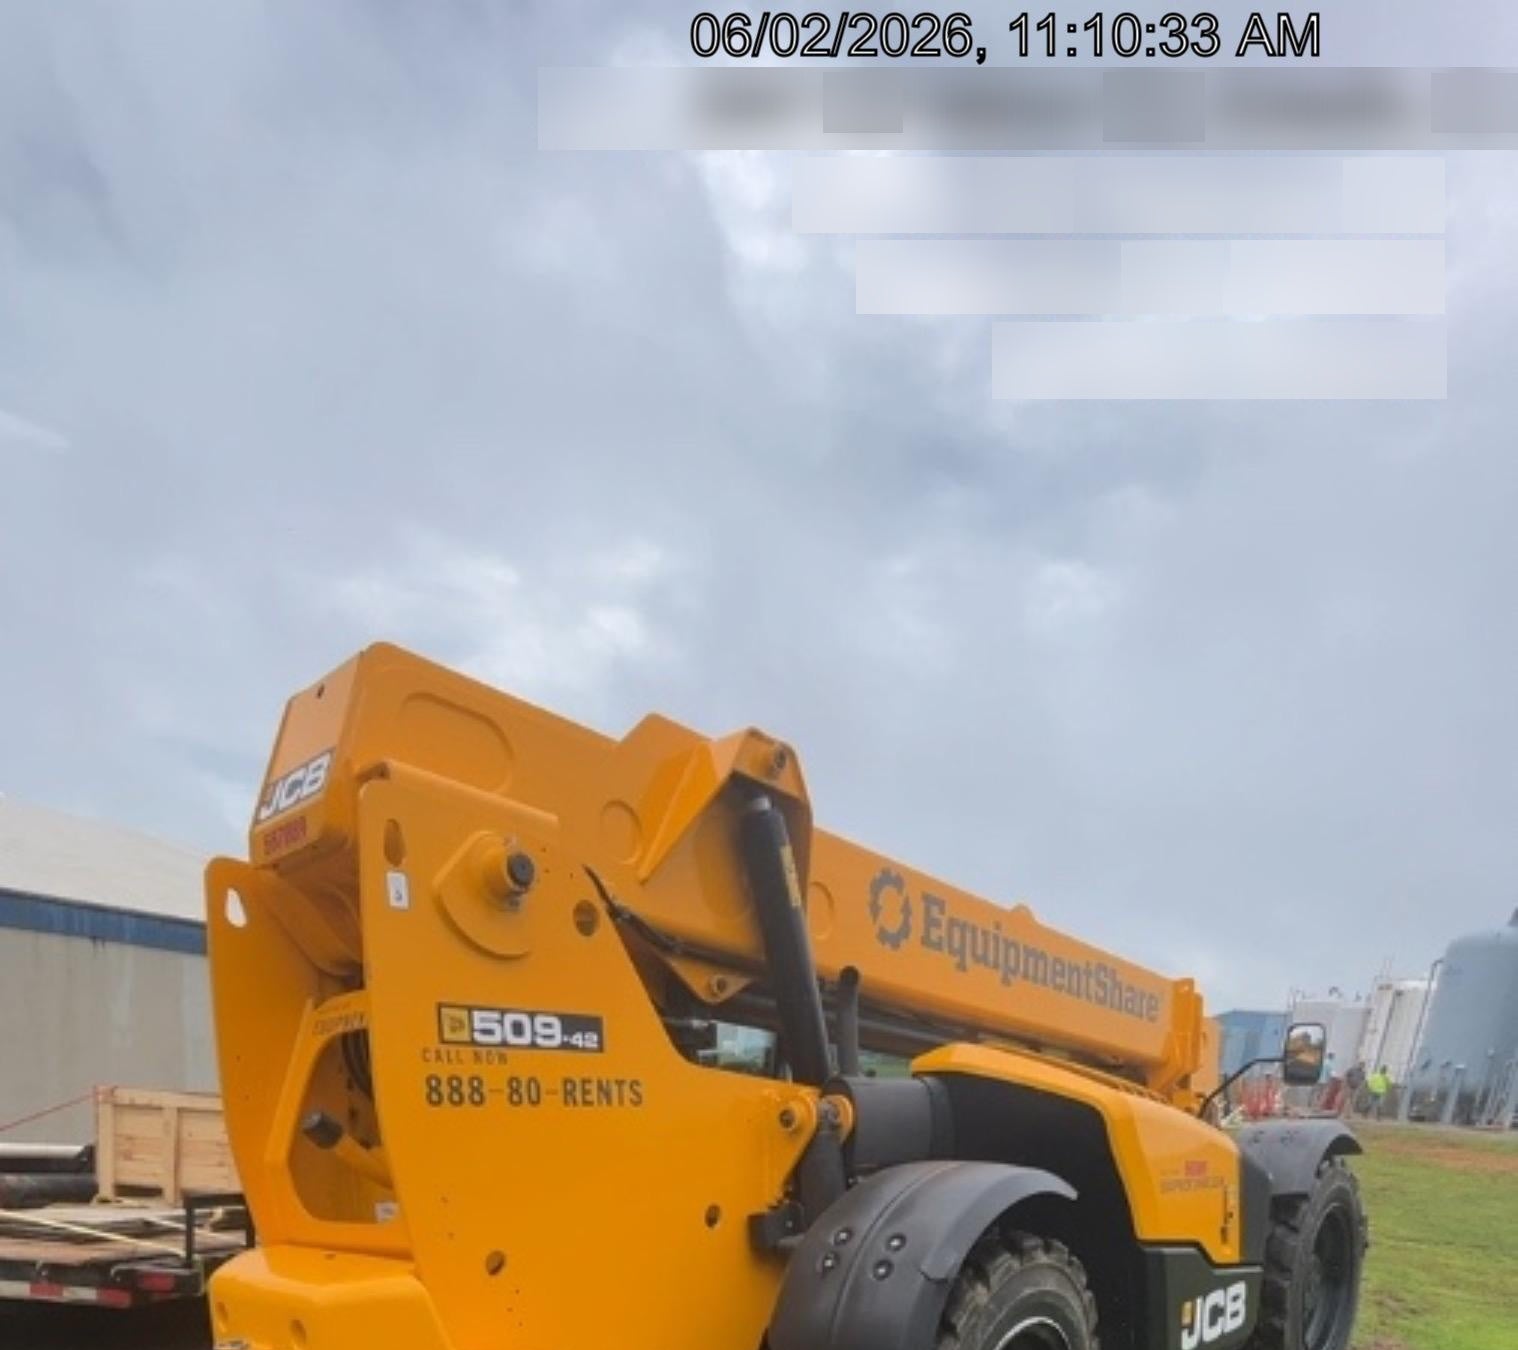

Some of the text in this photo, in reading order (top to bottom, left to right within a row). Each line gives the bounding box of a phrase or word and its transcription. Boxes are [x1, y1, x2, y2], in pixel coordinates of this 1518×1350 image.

[259, 751, 331, 820] JCB
[920, 891, 1161, 1023] EquipmentShare
[421, 1047, 508, 1066] CALL NOW
[471, 1009, 599, 1050] 509-42
[1181, 1280, 1246, 1350] JCB
